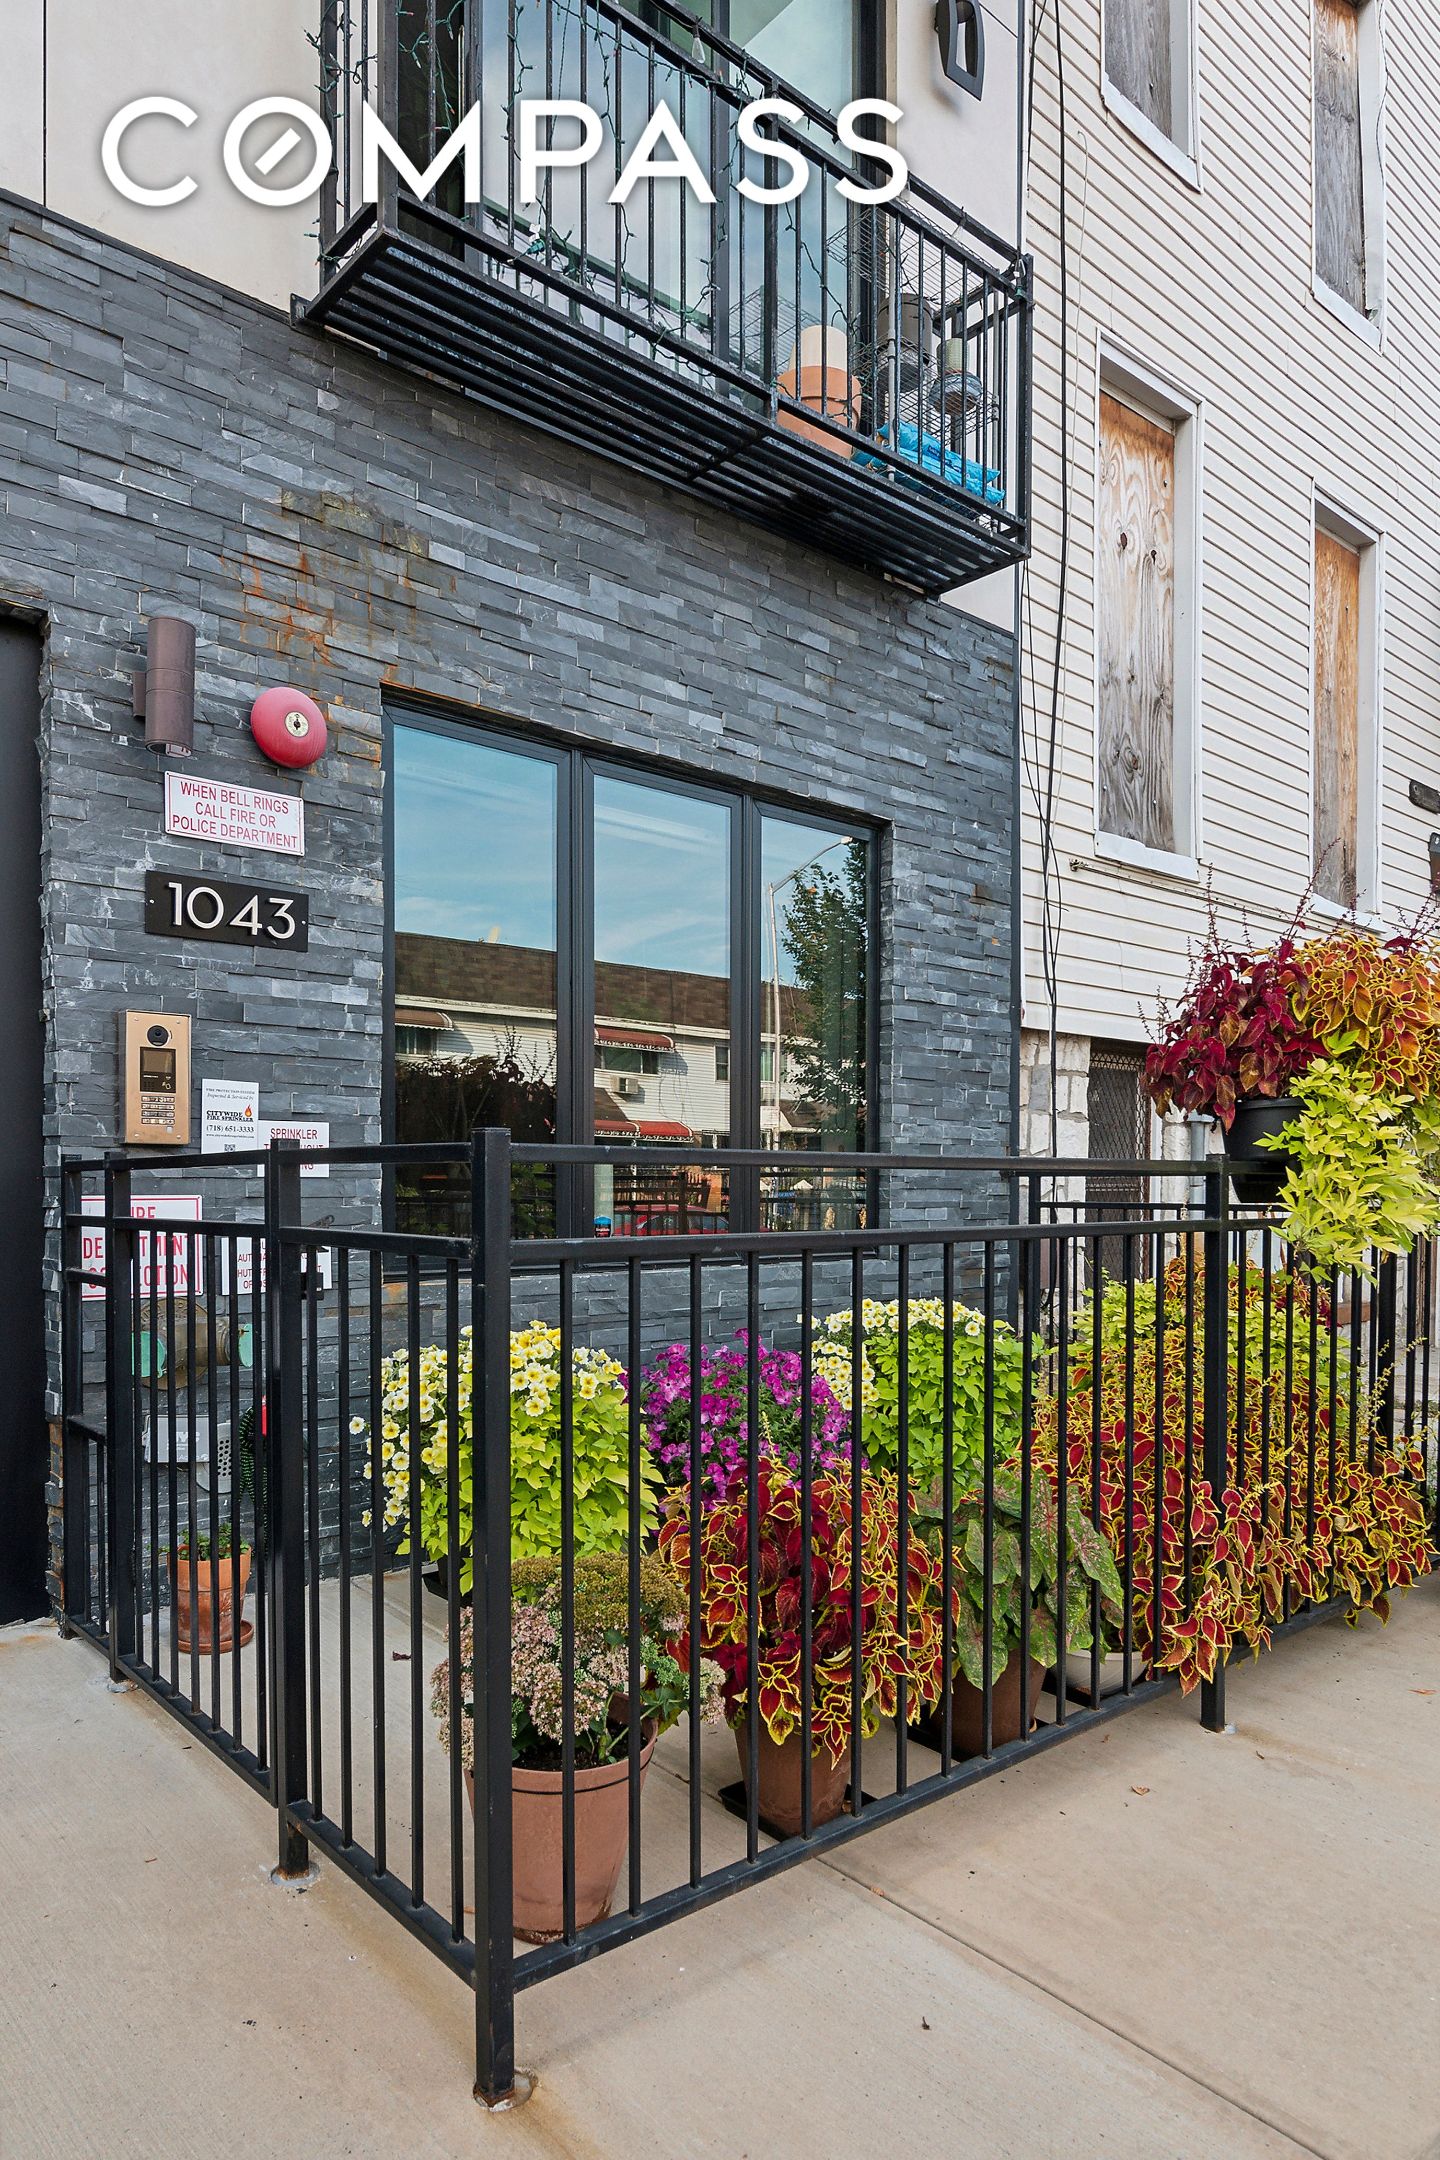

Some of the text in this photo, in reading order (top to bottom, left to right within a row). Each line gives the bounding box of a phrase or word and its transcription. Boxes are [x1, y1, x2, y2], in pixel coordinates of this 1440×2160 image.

[180, 781, 289, 815] WHEN BELL RINGS
[195, 802, 276, 828] CALL FIRE OR
[172, 814, 298, 849] POLICE DEPARTMENT
[168, 881, 296, 940] 1043
[206, 1110, 243, 1118] CITYWIDE
[206, 1124, 224, 1132] (718)
[270, 1128, 318, 1140] SPRINKLER
